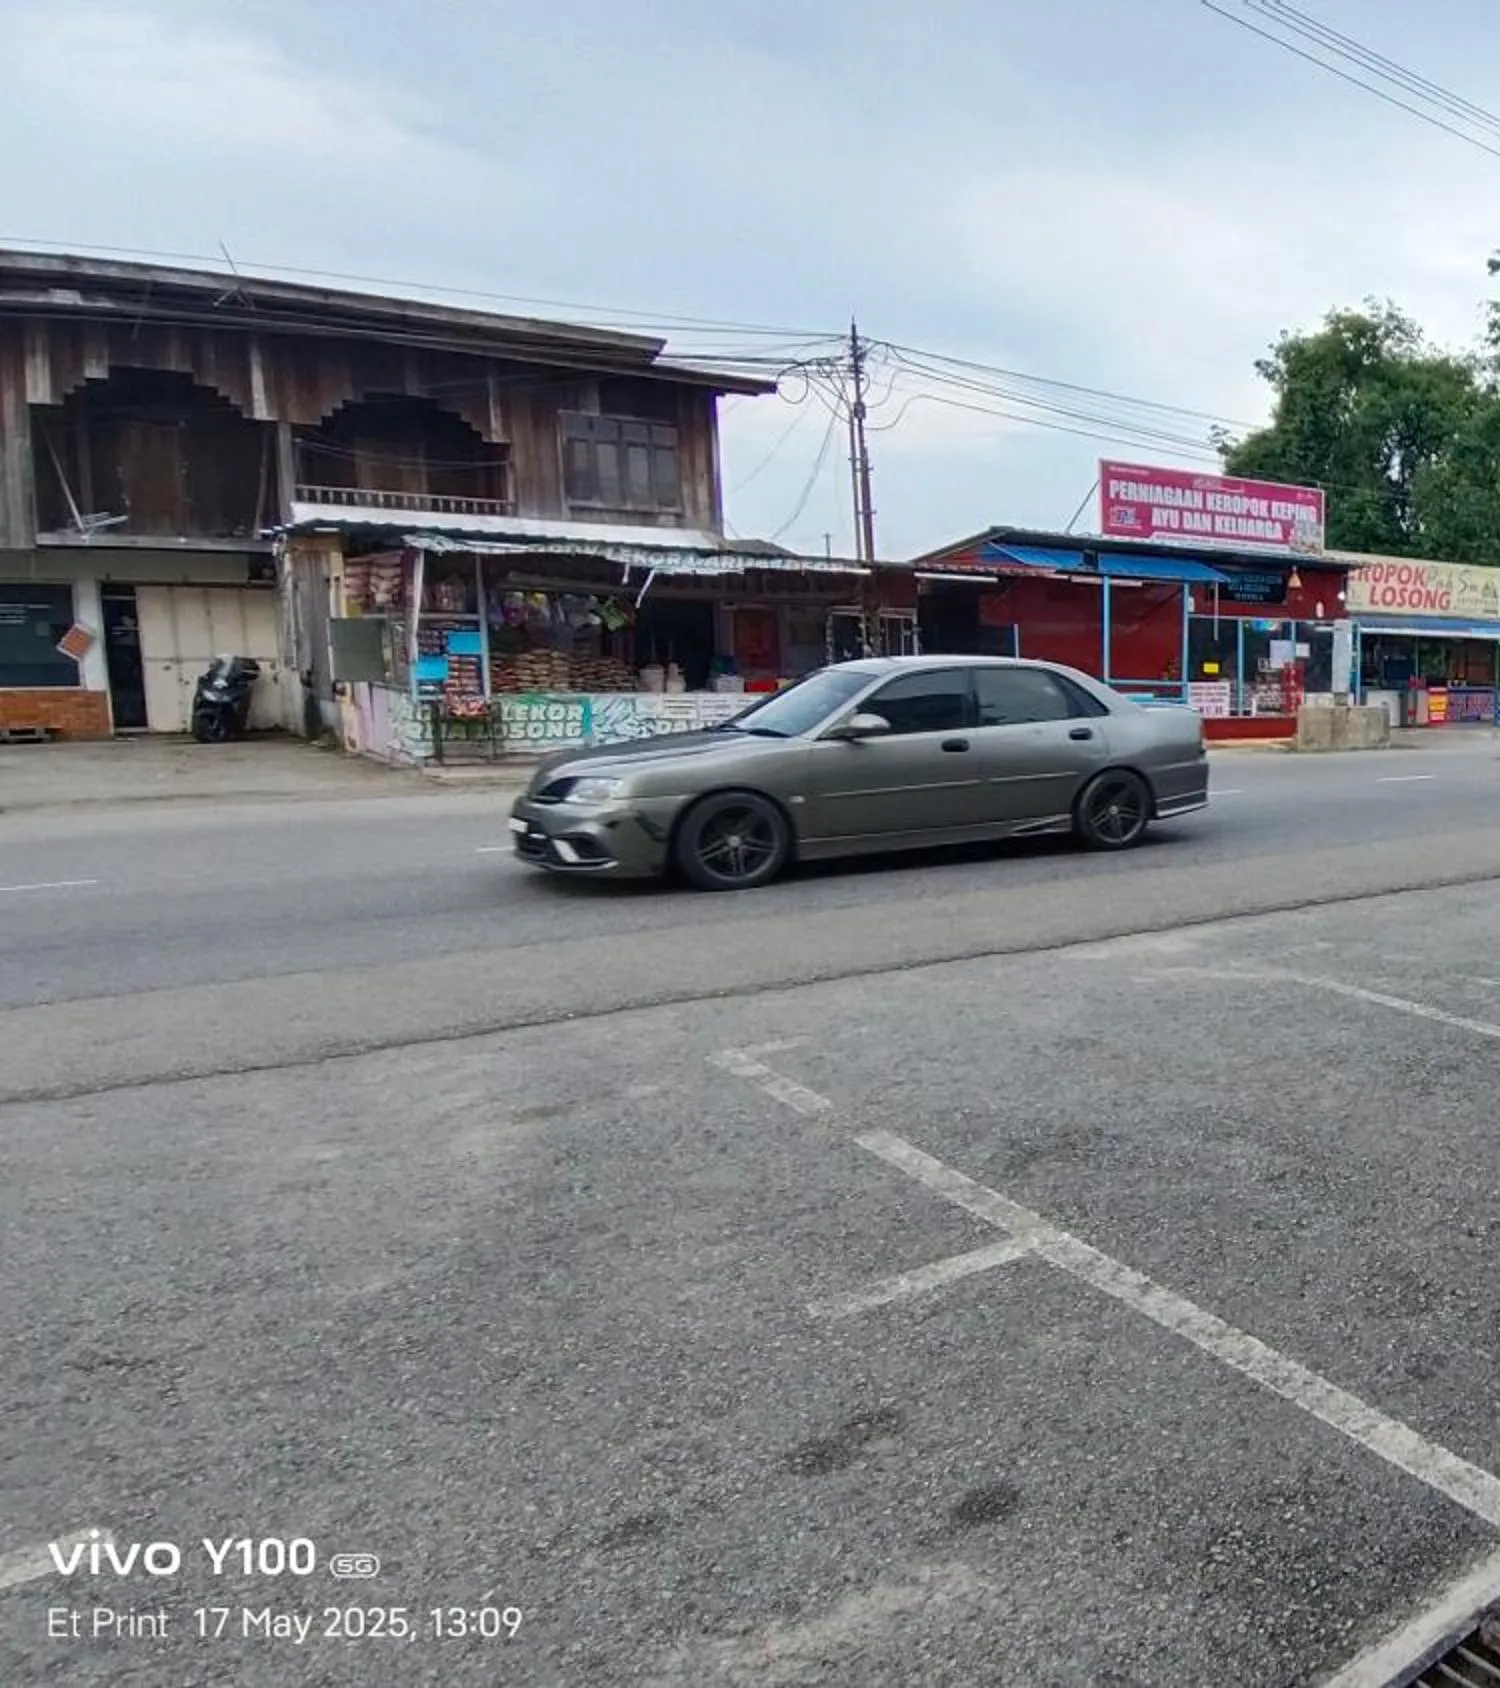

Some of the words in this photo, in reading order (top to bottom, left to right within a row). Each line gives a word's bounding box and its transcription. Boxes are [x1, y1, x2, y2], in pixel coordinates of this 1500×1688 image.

[1109, 479, 1203, 503] PERNIAGAAN
[1206, 492, 1269, 518] KEROPOK
[1271, 501, 1318, 523] KEPING
[1151, 507, 1180, 528] AYU
[1183, 511, 1212, 531] DAN
[1214, 515, 1284, 540] KELUARGA
[1369, 585, 1452, 611] LOSONG
[501, 702, 583, 721] LEKOR
